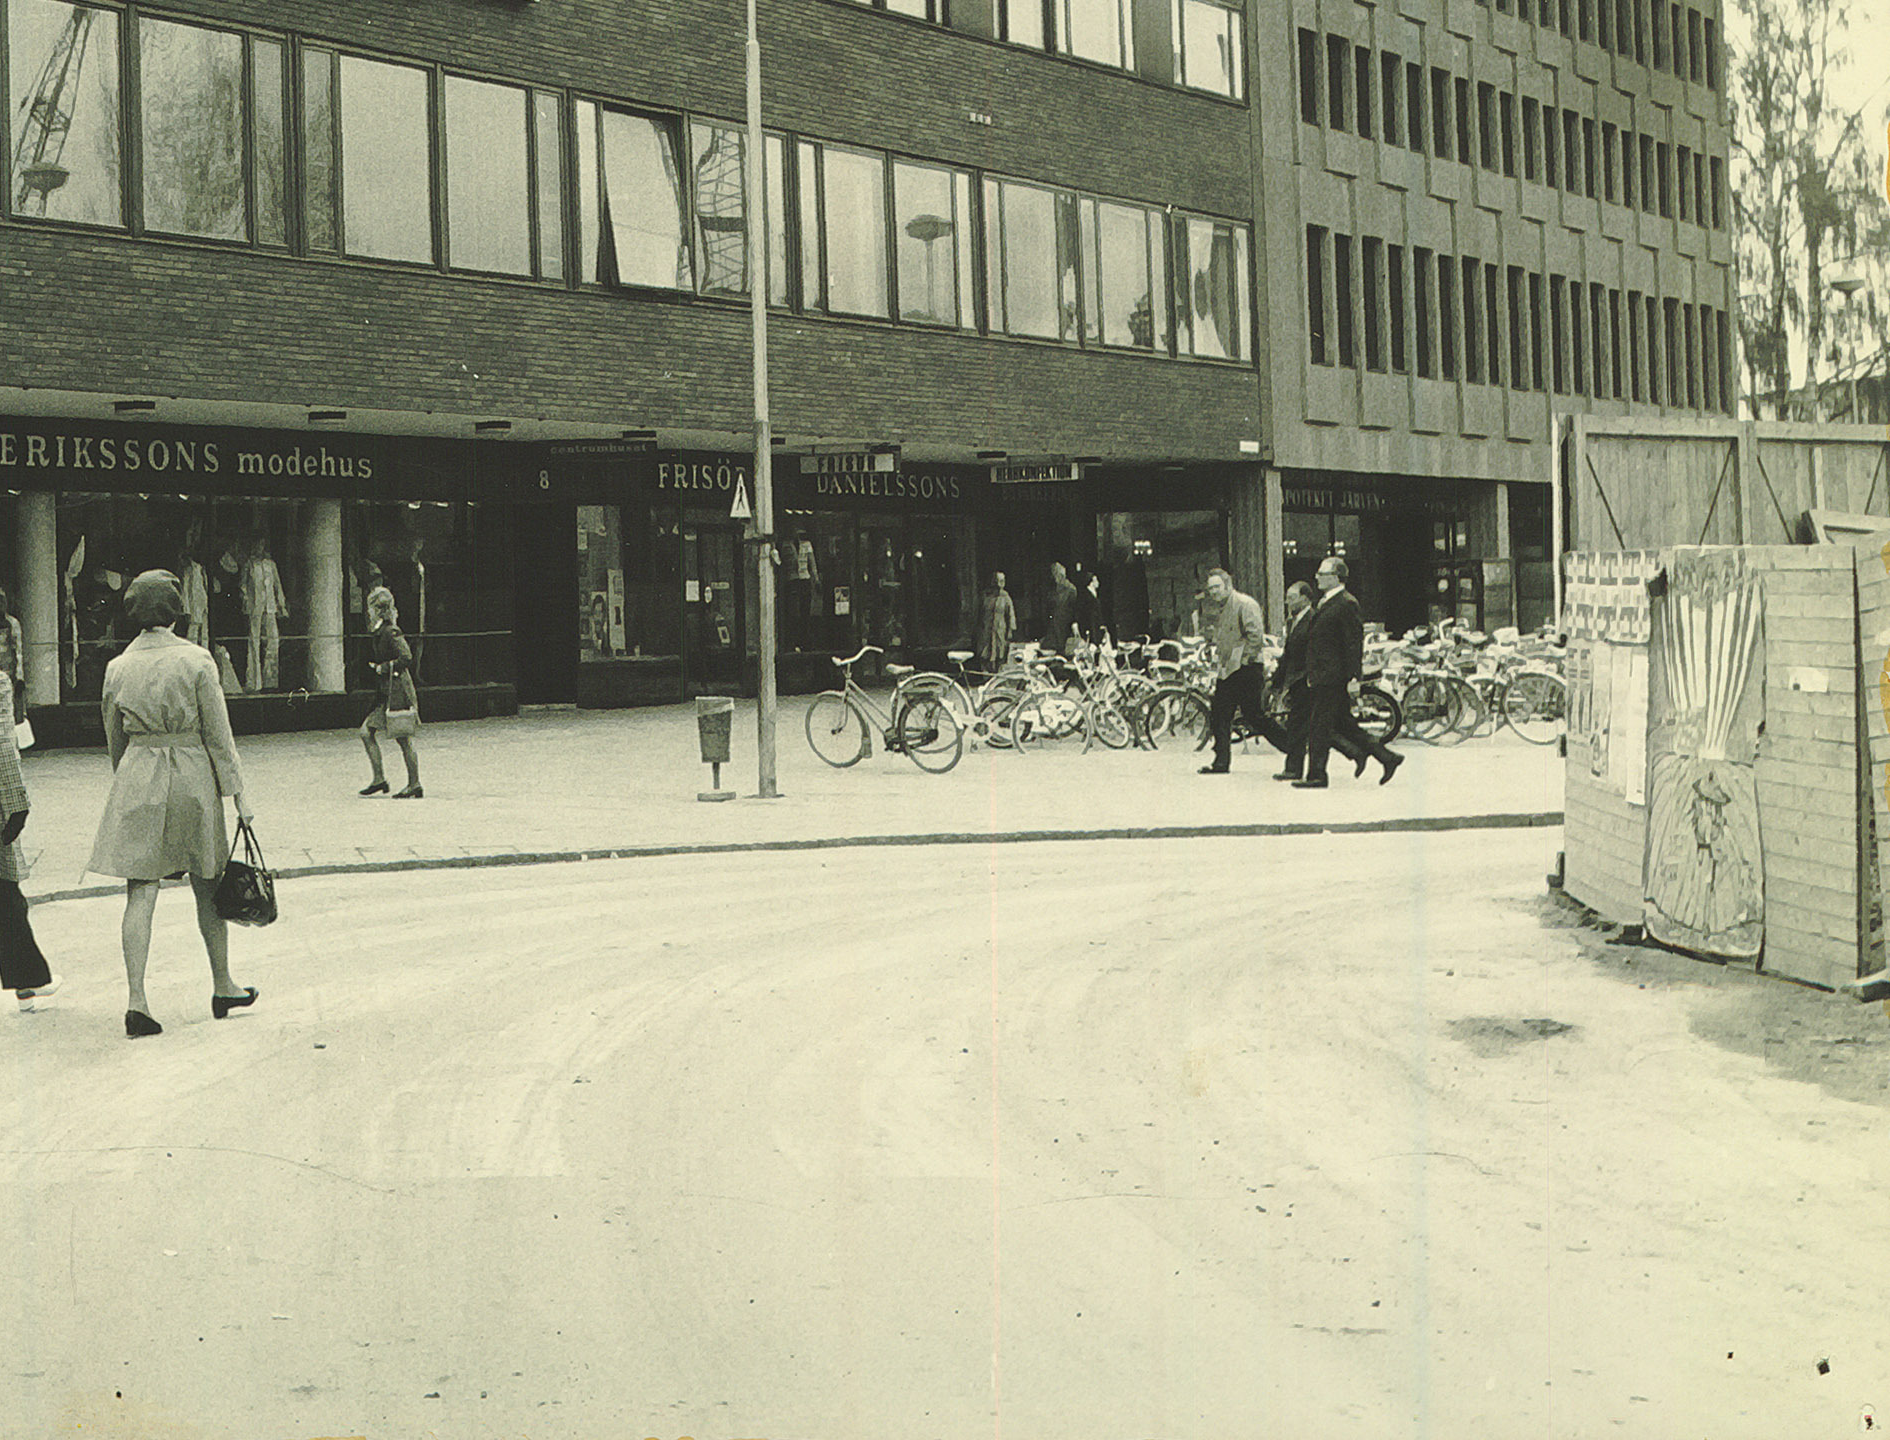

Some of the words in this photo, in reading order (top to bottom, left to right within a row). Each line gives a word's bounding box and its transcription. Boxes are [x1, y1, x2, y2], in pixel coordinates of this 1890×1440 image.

[0, 432, 221, 474] ERIKSSONS
[237, 448, 373, 480] modehus
[539, 470, 550, 490] 8
[817, 472, 960, 499] DANIELSSONS
